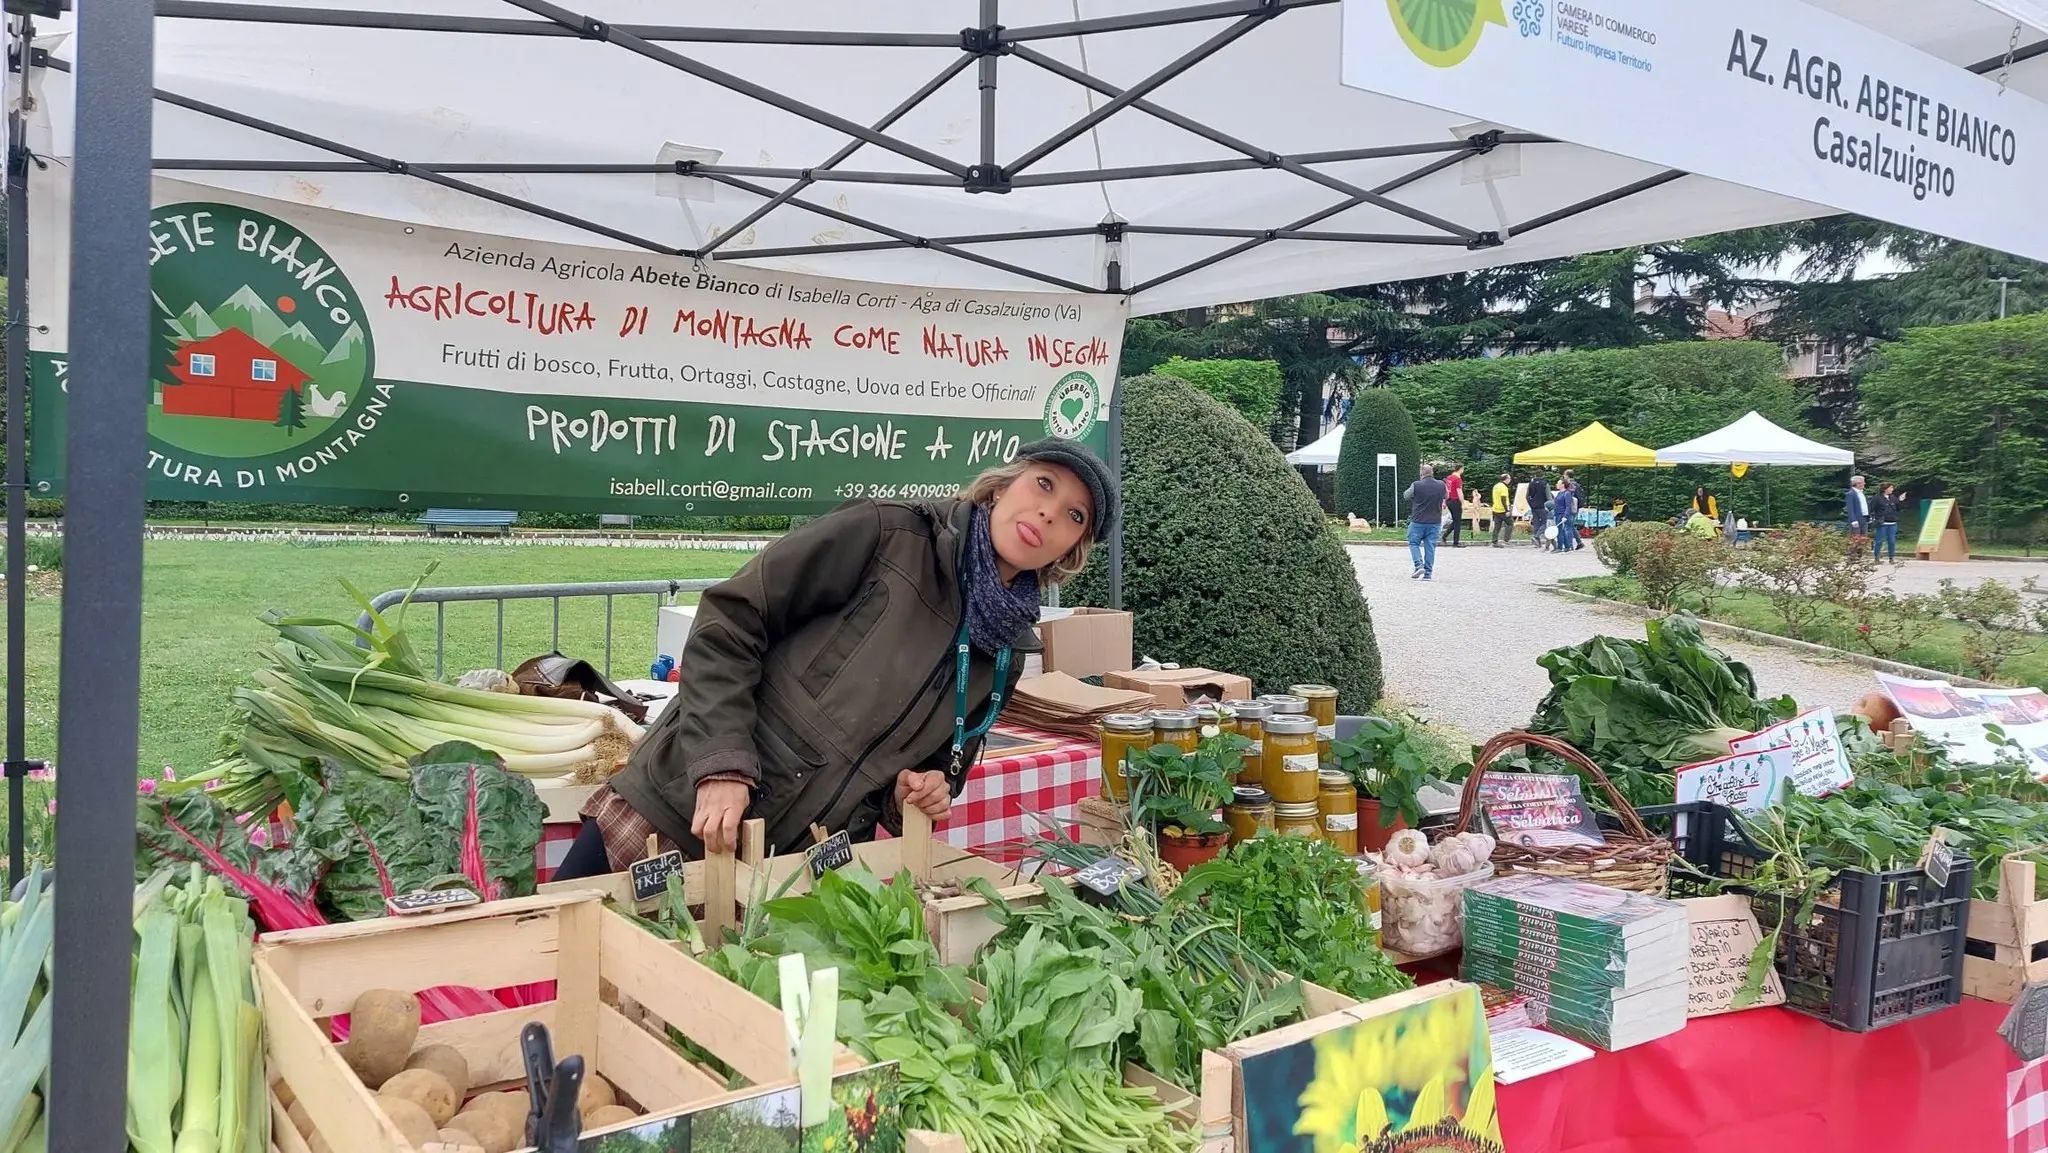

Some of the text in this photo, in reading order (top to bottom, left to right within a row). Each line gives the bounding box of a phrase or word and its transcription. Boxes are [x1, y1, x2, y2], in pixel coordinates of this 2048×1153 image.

[1557, 1, 1657, 46] CAMERA DI COMMERCIO
[1557, 16, 1589, 38] VARESE
[1557, 31, 1653, 73] Futuro Impresa Territorio
[1727, 28, 2016, 167] AZ. AGR. ABETE BIANCO
[1812, 115, 1956, 201] Casalzuigno
[237, 217, 353, 325] BIANCO
[444, 241, 535, 271] Azienda
[541, 255, 626, 282] Agricola
[630, 264, 691, 290] Abete
[695, 272, 760, 297] Bianco
[765, 283, 783, 299] di
[788, 284, 852, 307] Isabella
[856, 291, 897, 309] Corti
[909, 296, 941, 315] Aga
[945, 297, 960, 313] di
[964, 299, 1051, 321] Casalzuigno
[1054, 303, 1083, 323] (Va)
[384, 275, 1110, 369] AGRICOLTURA DI MONTAGNA COME NATURA INSEGNA
[442, 343, 1036, 403] Frutti di bosco, Frutta, Ortaggi, Castagne, Uova ed Erbe Officinali
[236, 468, 266, 490] DI
[276, 382, 396, 483] MONTAGNA
[526, 404, 677, 455] PRODOTTI
[704, 414, 736, 457] DI
[762, 418, 908, 463] STAGIONE
[925, 425, 954, 462] A
[610, 477, 961, 502] isabell.corti@gmail.com +39 366 4909039
